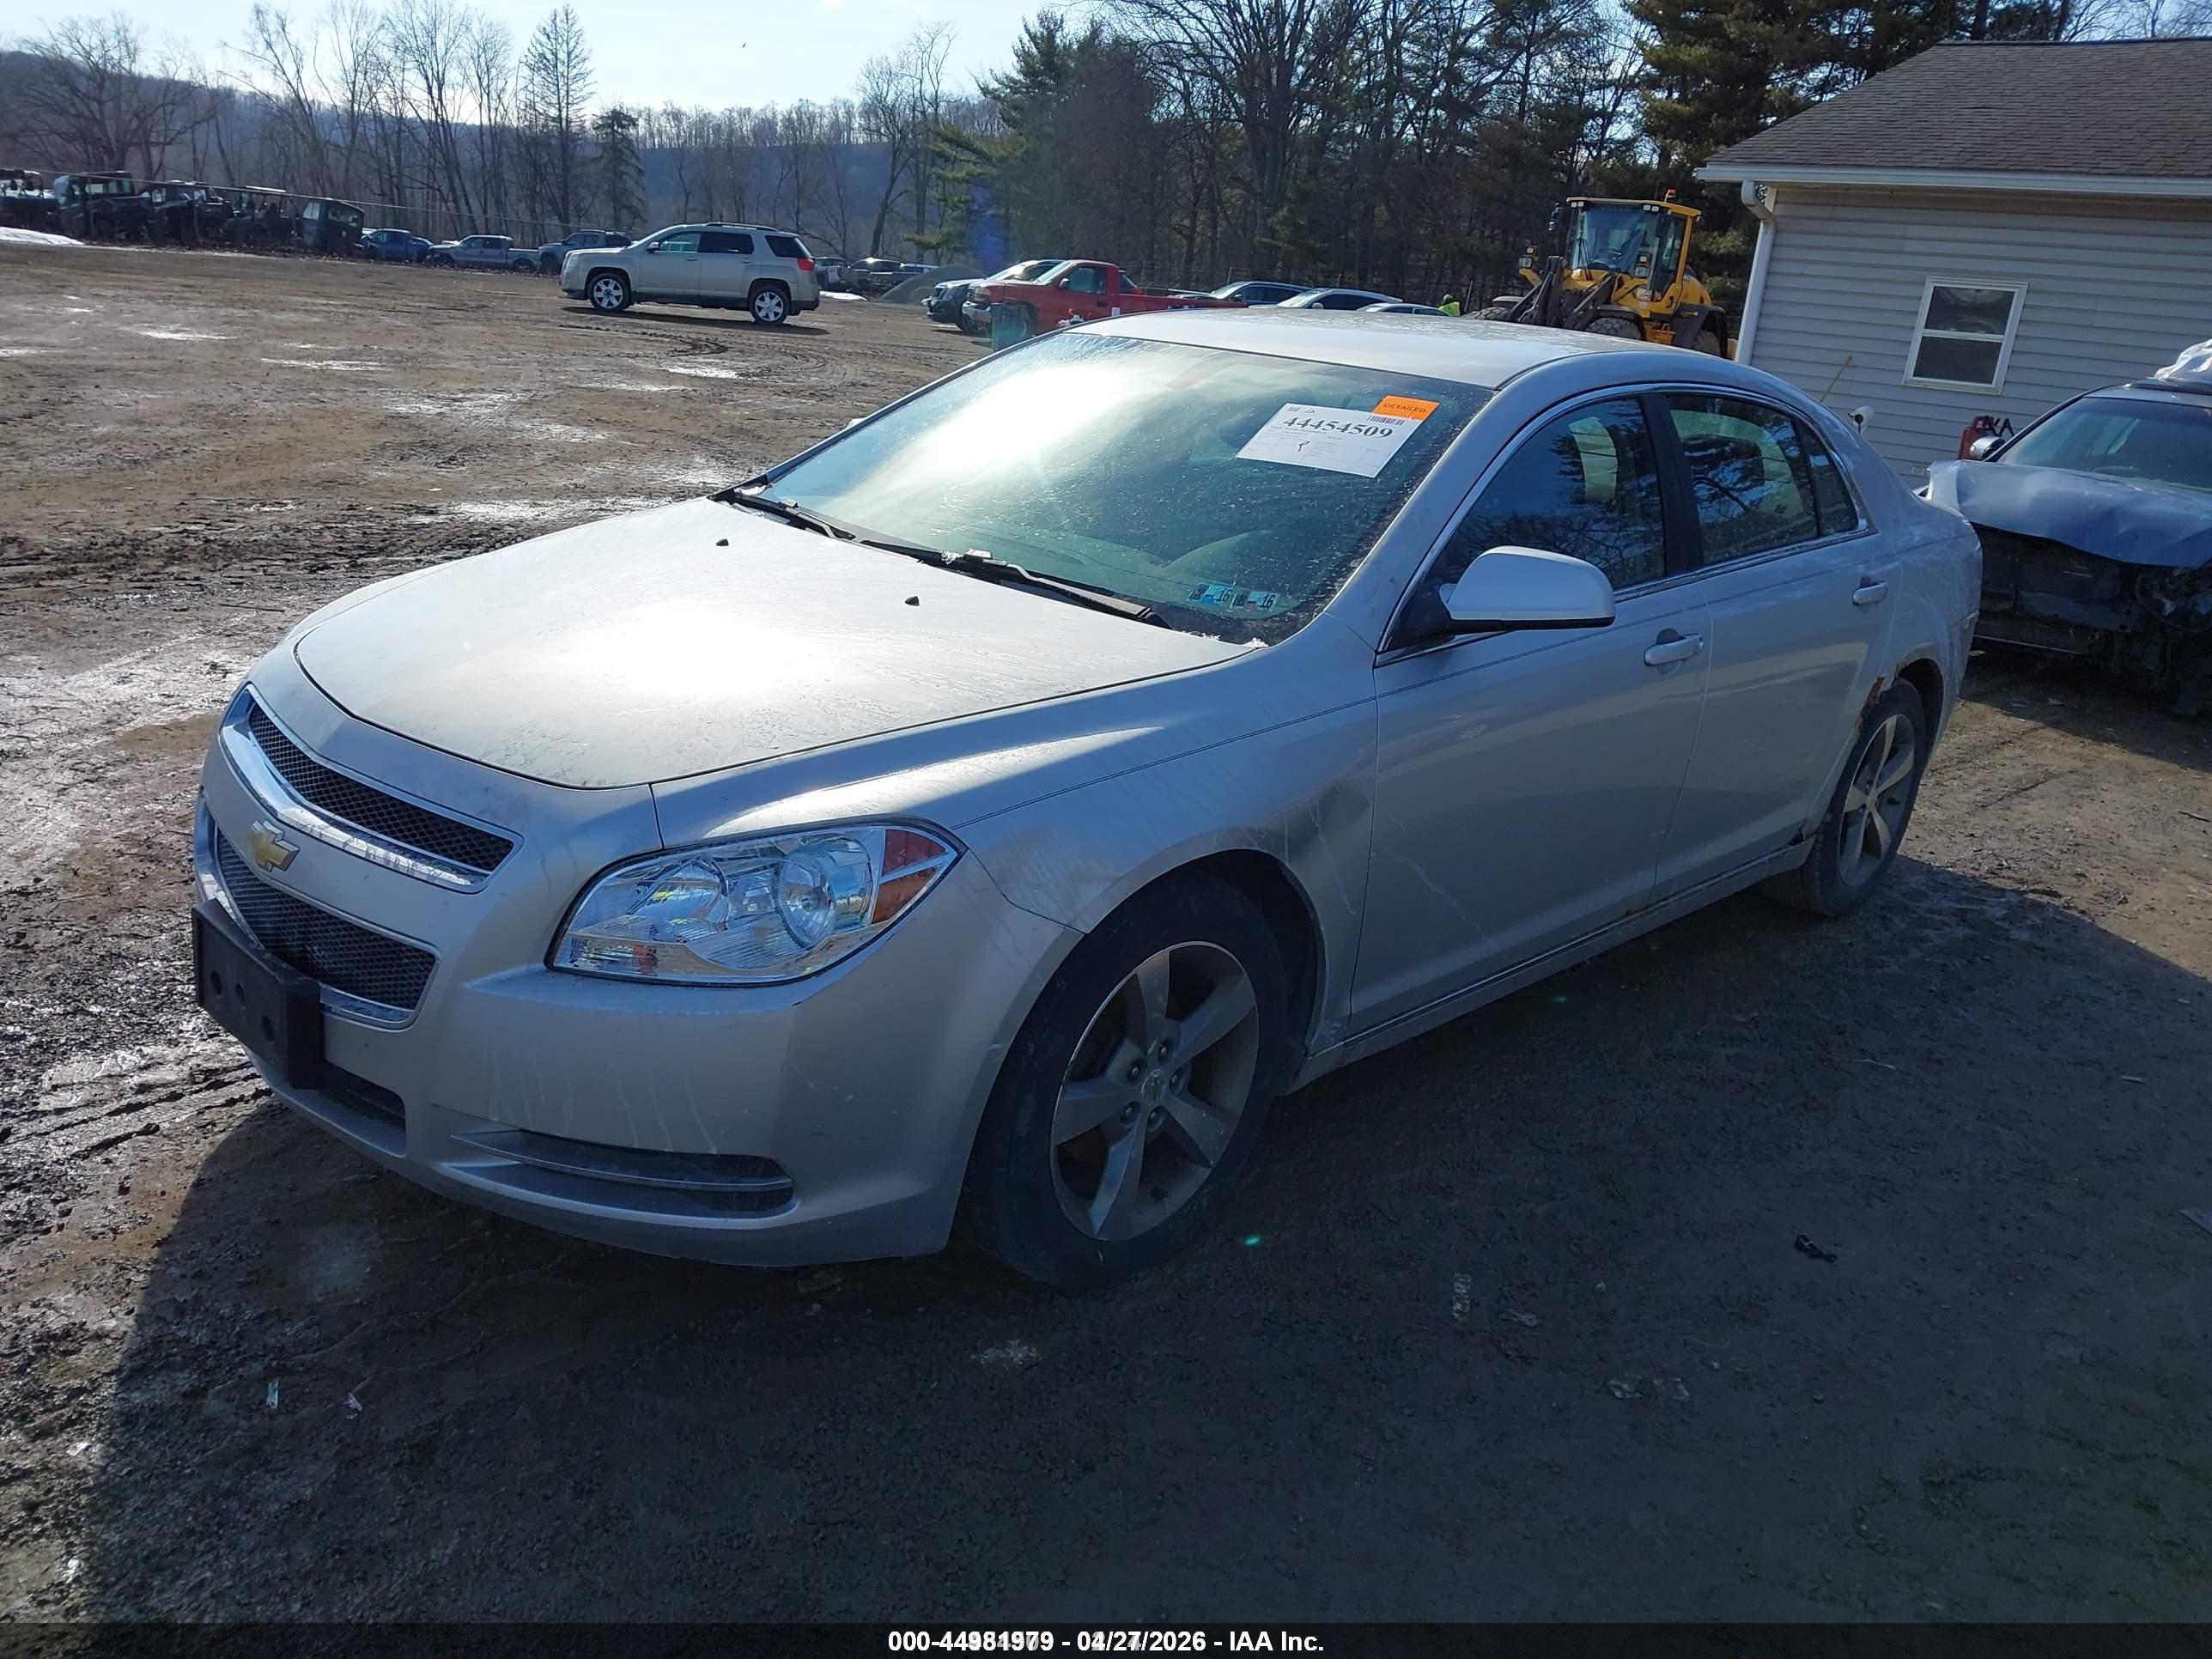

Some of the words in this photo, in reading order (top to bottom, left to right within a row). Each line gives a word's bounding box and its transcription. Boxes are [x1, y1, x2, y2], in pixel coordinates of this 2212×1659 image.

[1382, 403, 1427, 413] DETAILED
[1283, 416, 1394, 439] 44454509
[1217, 589, 1232, 602] 16
[1260, 593, 1276, 609] 16
